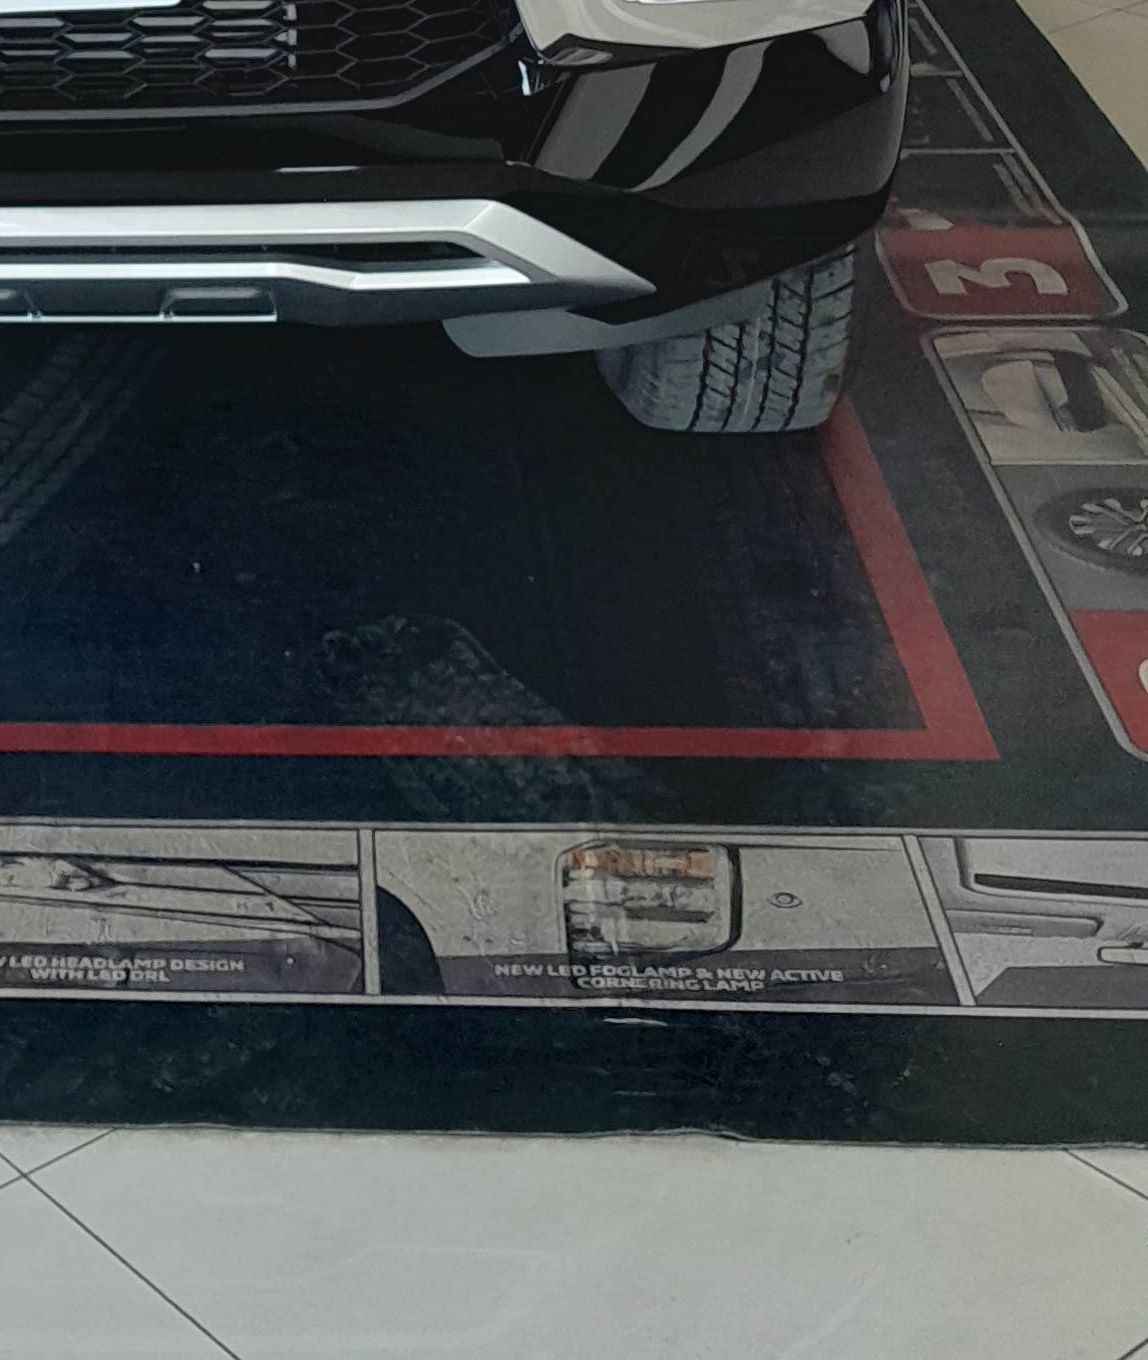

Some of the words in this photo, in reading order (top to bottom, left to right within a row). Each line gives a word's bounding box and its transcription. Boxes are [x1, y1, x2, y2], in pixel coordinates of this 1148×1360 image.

[8, 955, 48, 969] LED
[51, 955, 167, 971] HEADLAMP
[169, 958, 245, 972] DESIGN
[30, 967, 86, 981] WITH
[128, 968, 171, 982] DRL
[494, 964, 545, 977] NEW
[546, 964, 588, 977] LED
[590, 965, 693, 980] FOGLAMP
[695, 967, 714, 980] &
[716, 968, 767, 981] NEW
[769, 969, 845, 982] ACTIVE
[576, 977, 700, 991] CORNERING
[703, 980, 765, 993] LAMP
